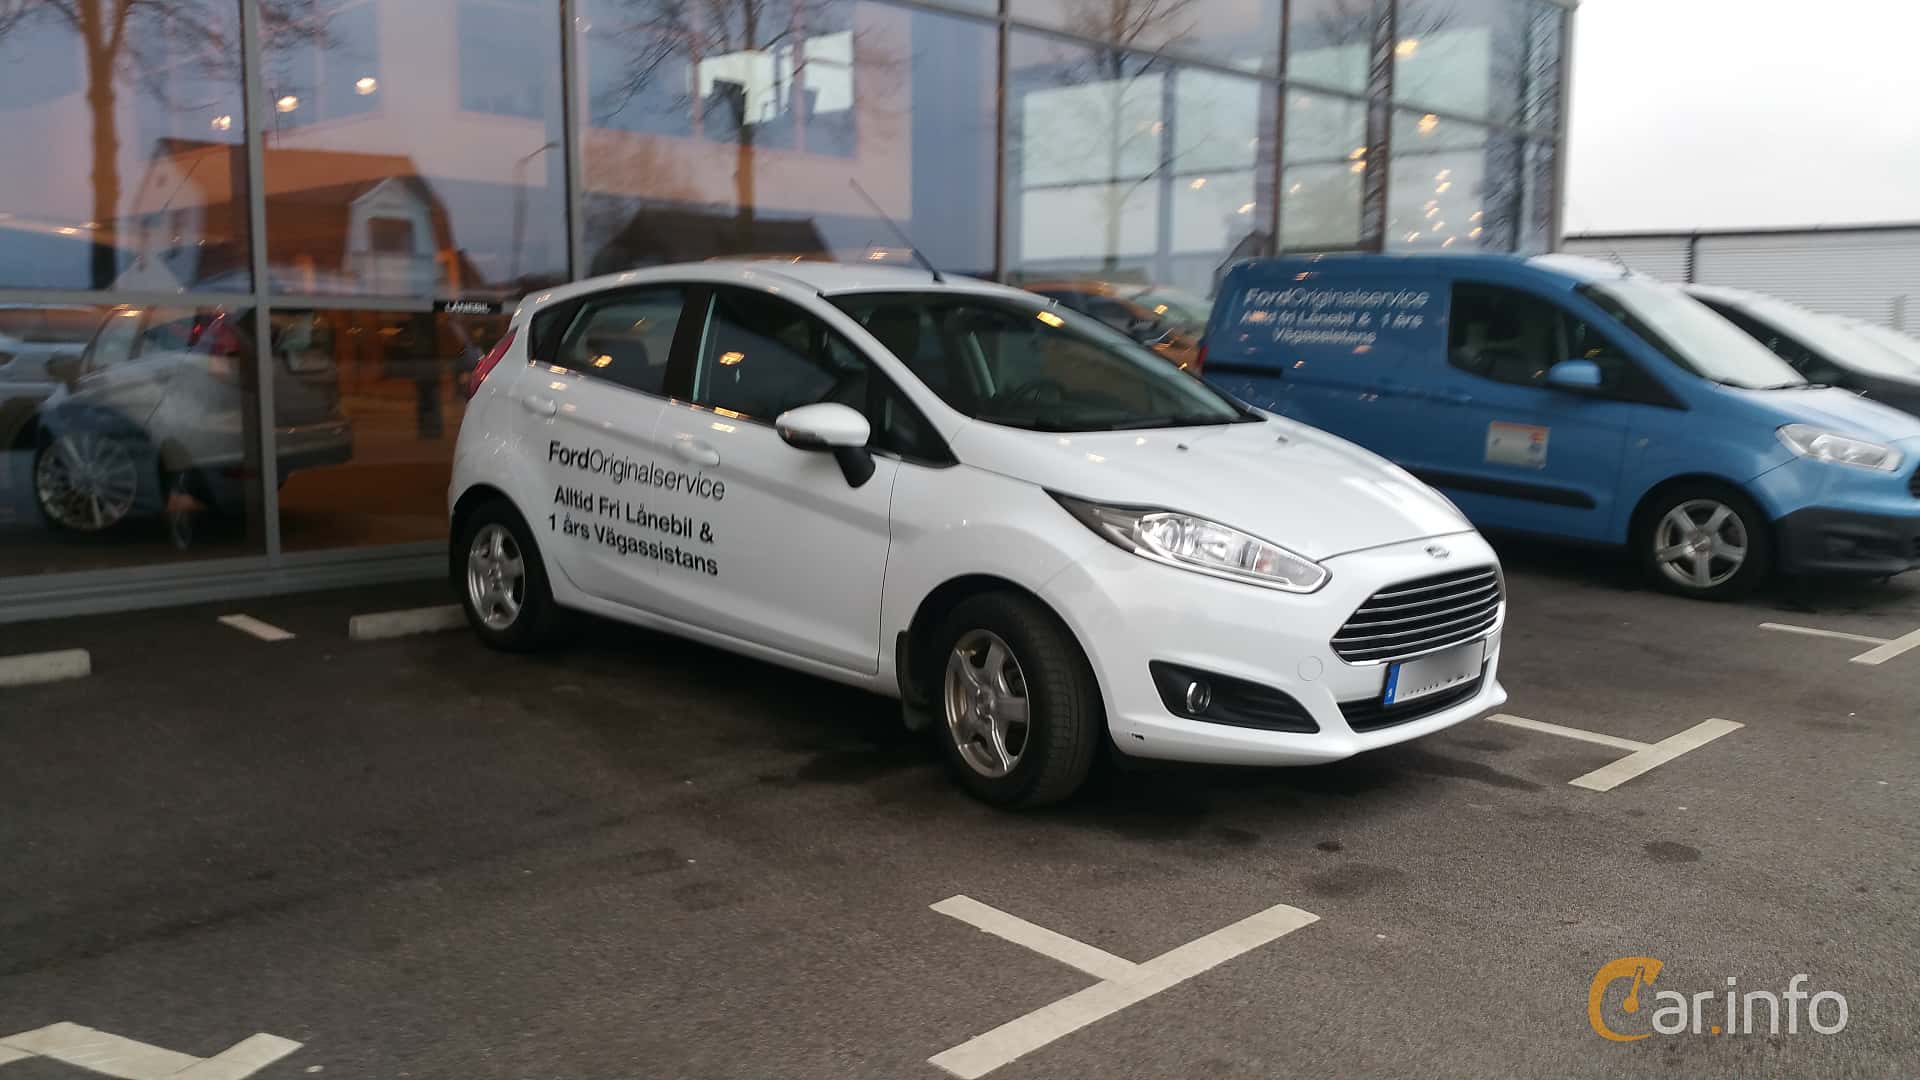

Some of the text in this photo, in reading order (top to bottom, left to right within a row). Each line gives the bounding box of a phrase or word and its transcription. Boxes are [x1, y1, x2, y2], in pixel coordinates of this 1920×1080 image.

[549, 511, 719, 576] 1 års Vägassistans
[554, 485, 714, 544] Alltid Fri Lånebil &
